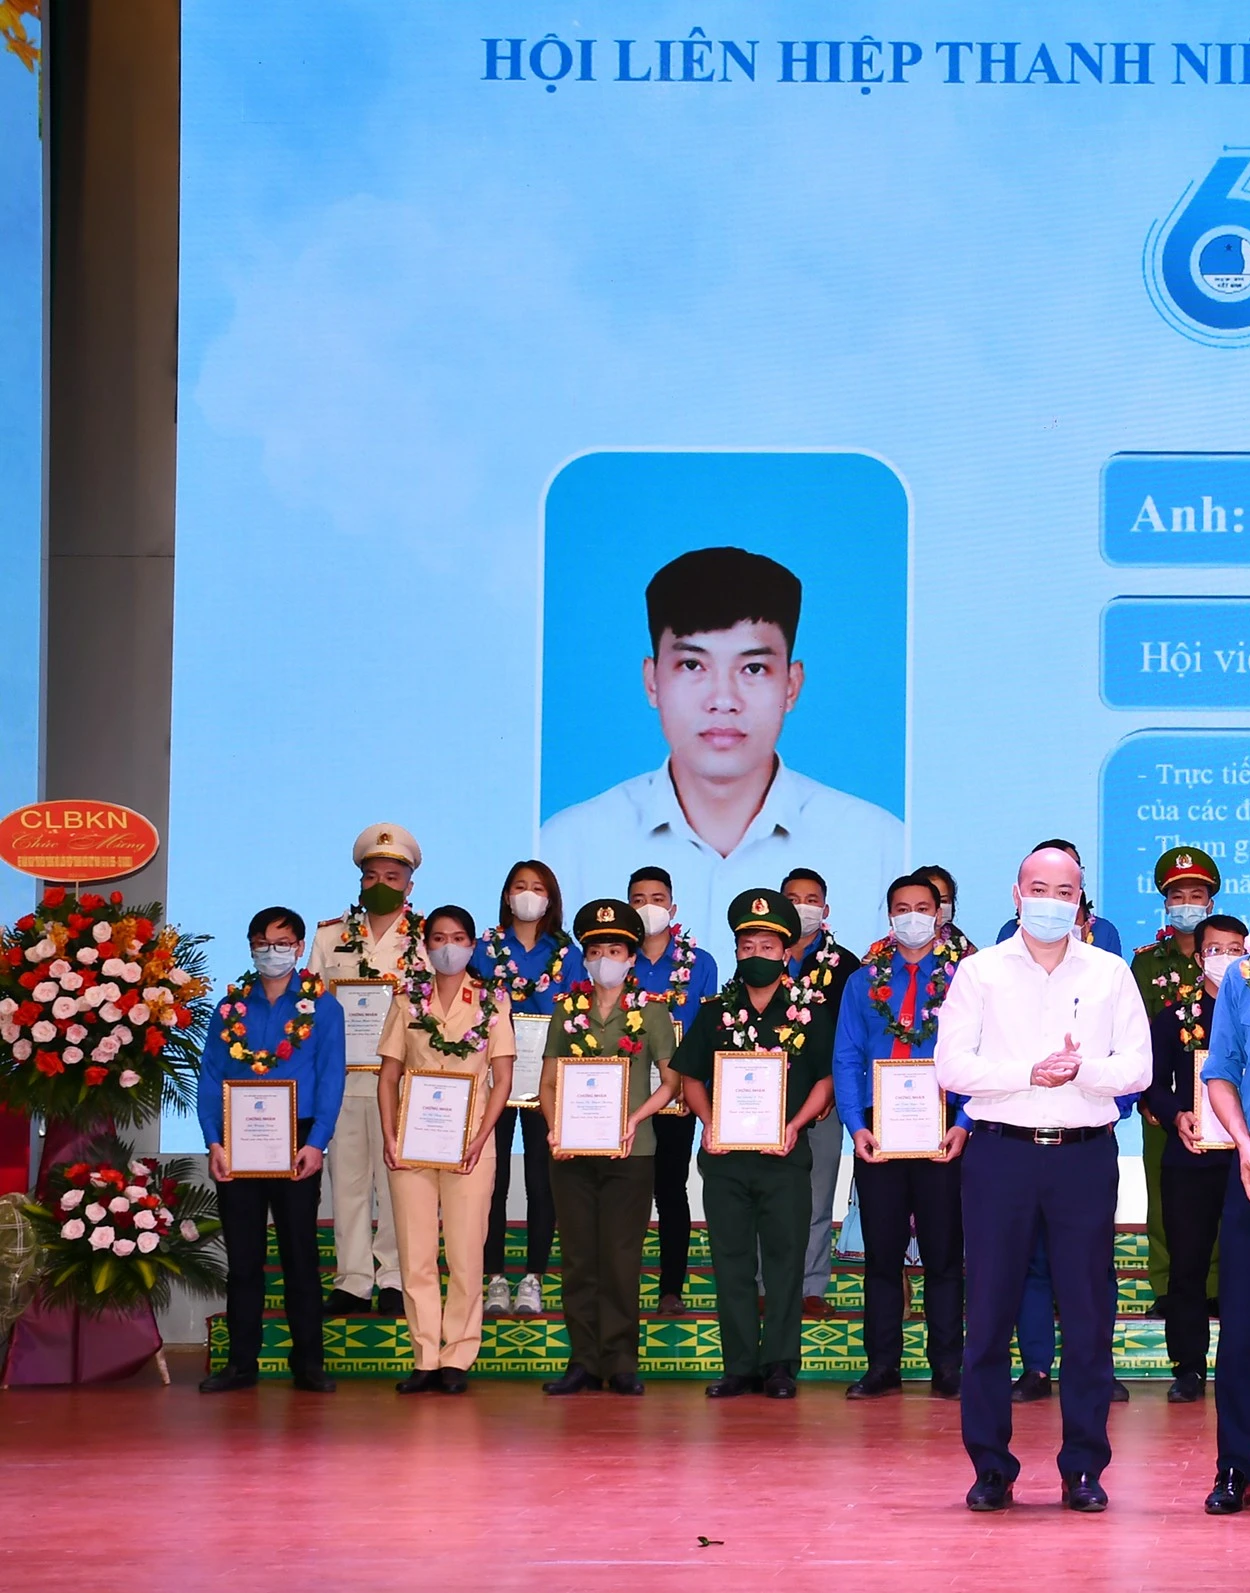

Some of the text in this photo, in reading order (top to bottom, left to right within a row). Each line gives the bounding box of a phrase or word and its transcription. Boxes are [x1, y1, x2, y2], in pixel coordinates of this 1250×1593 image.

[481, 33, 597, 93] HỘI
[614, 26, 759, 82] LIÊN
[777, 35, 922, 95] HIỆP
[936, 41, 1155, 85] THANH
[1130, 494, 1244, 533] Anh:
[1140, 641, 1202, 678] Hội
[1156, 763, 1213, 789] Trực
[20, 810, 128, 829] CLBKN
[1137, 798, 1179, 821] của
[1187, 800, 1228, 821] các
